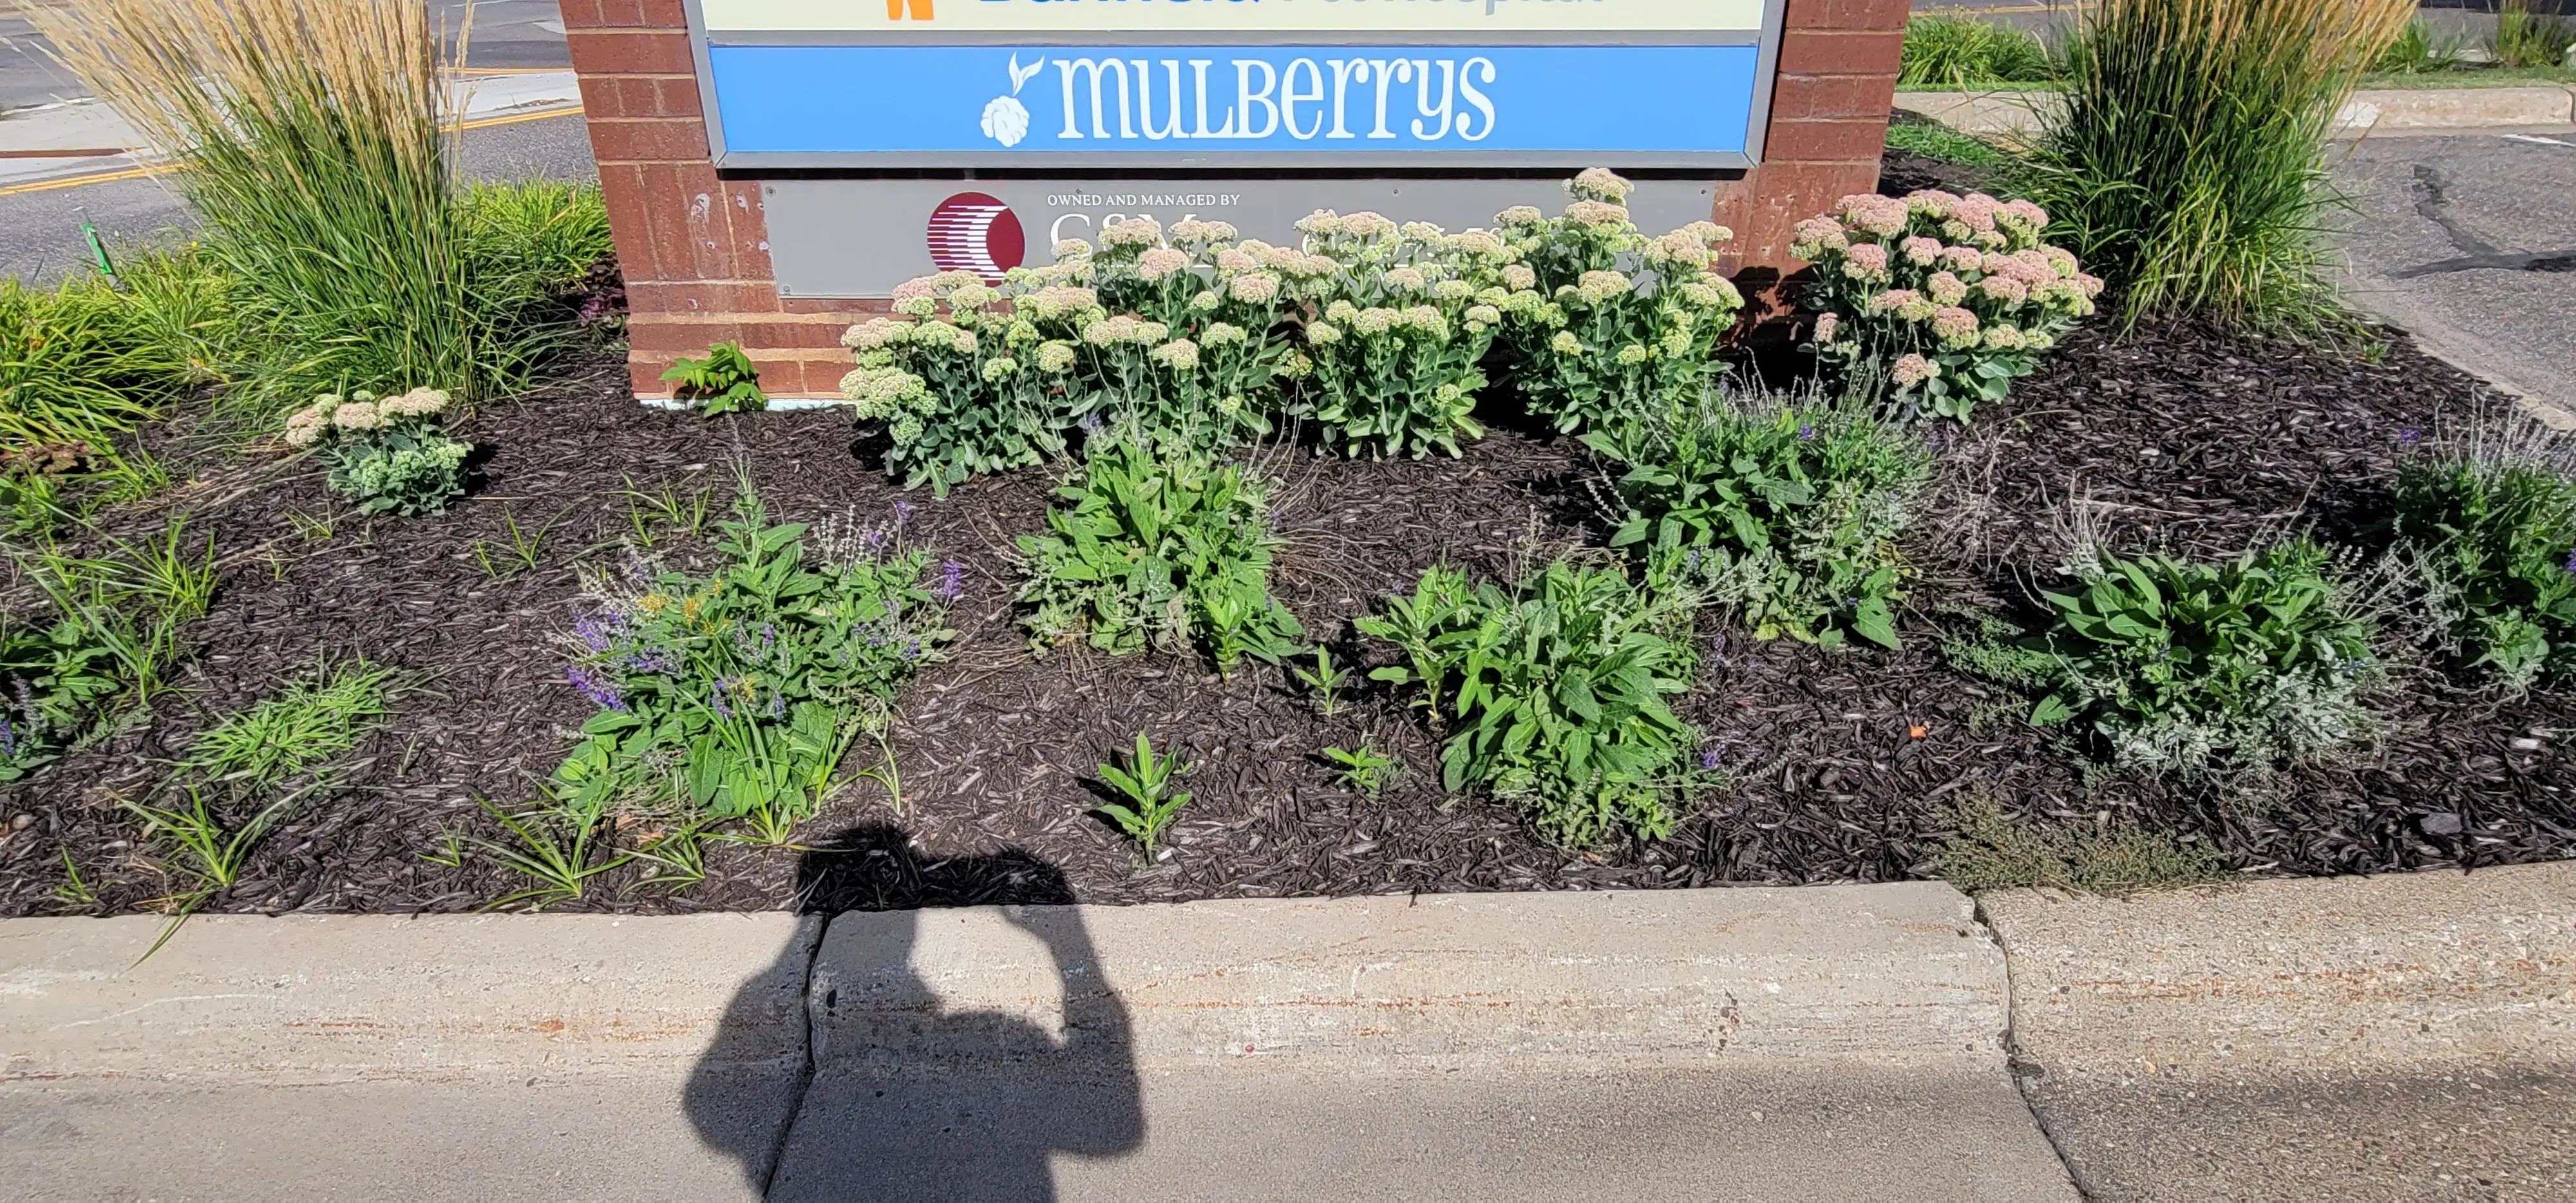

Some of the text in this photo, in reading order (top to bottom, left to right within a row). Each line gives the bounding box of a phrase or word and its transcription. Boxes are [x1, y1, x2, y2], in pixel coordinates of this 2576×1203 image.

[1048, 194, 1240, 206] OWNED AND MANAGED BY
